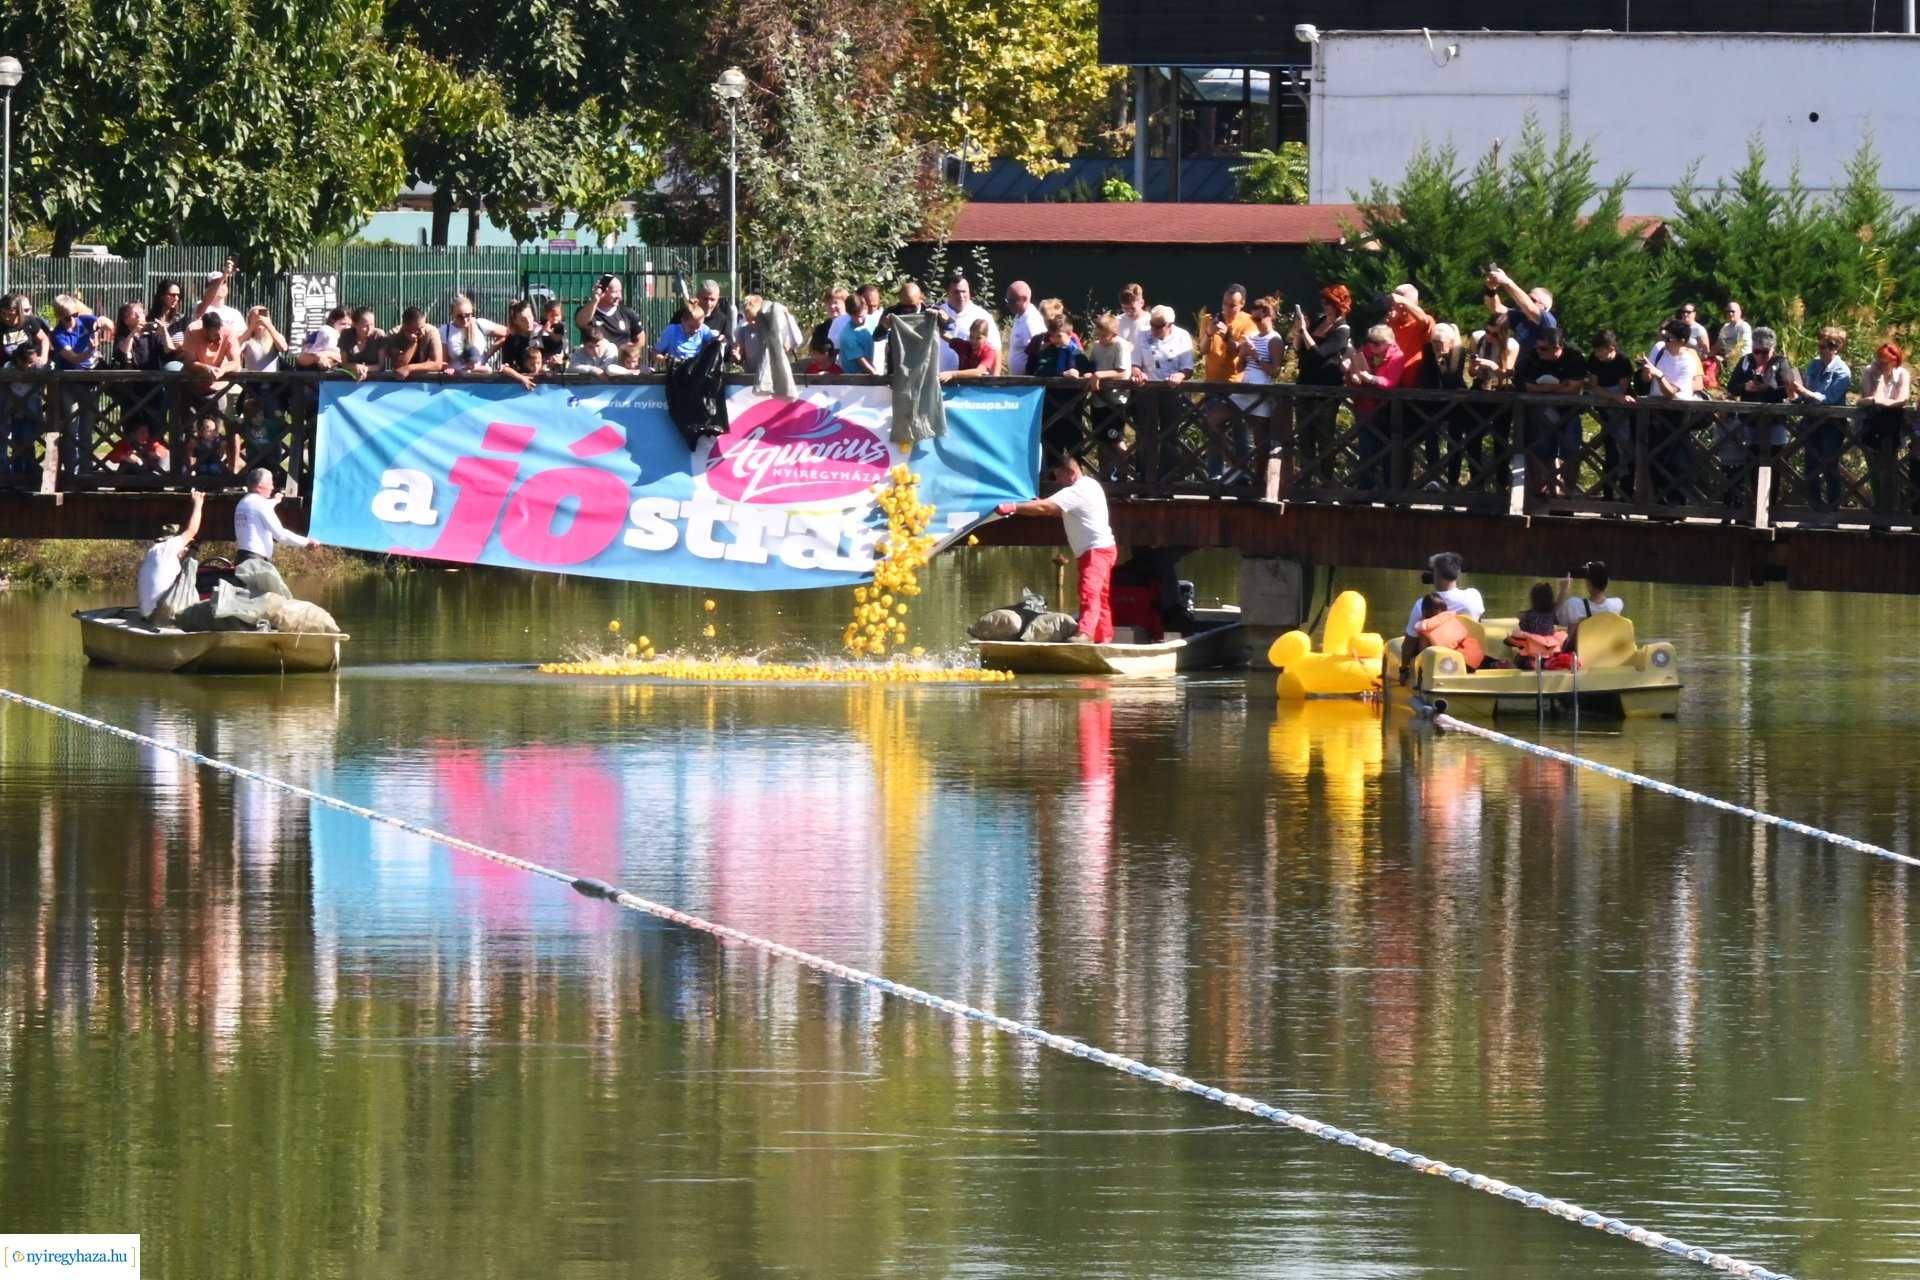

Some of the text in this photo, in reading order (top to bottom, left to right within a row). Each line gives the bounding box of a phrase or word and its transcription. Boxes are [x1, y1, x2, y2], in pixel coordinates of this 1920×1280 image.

[371, 468, 437, 526] a
[388, 422, 631, 566] jó
[706, 426, 888, 503] Aquarius
[772, 468, 881, 483] NYÍREGYHÁZA
